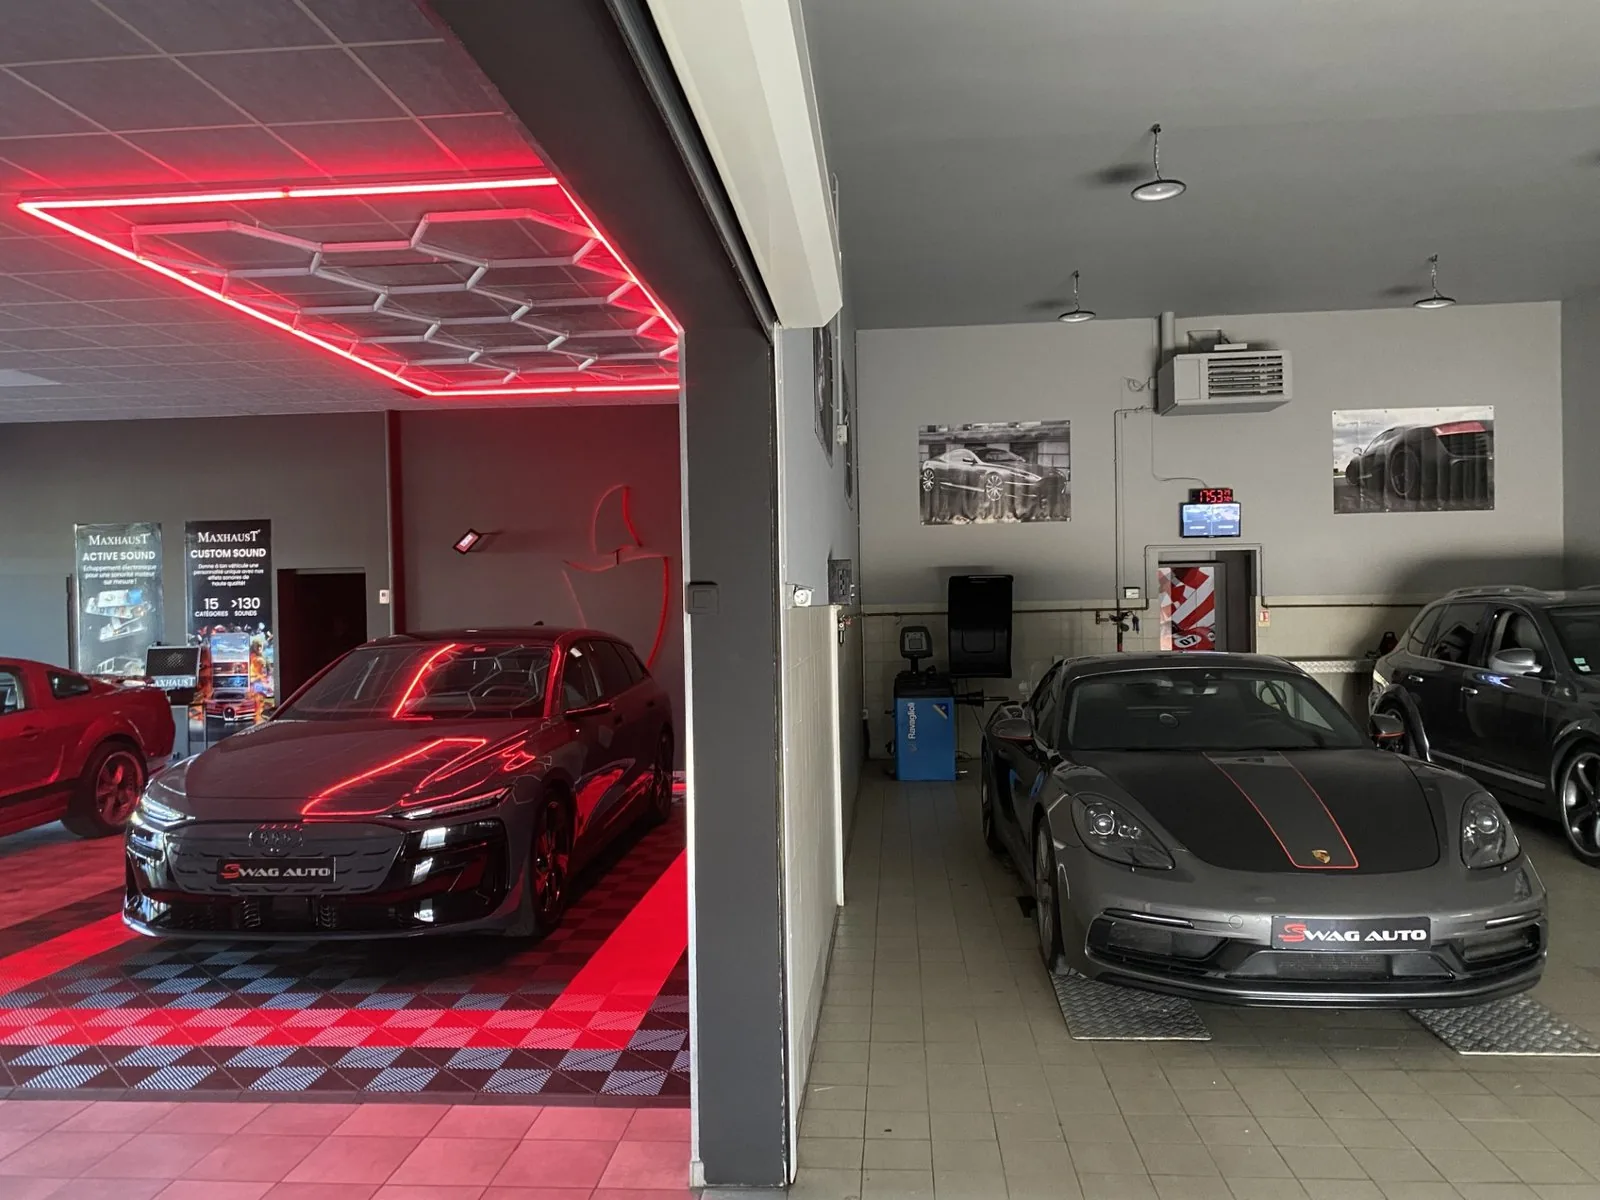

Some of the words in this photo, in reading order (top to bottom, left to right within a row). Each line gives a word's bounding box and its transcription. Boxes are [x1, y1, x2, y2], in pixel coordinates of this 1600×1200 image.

[82, 551, 118, 561] ACTIVE
[120, 550, 156, 560] SOUND
[190, 548, 231, 558] CUSTOM
[233, 548, 266, 558] SOUND
[204, 597, 219, 610] 15
[154, 676, 196, 688] AXHAUST
[221, 863, 280, 879] SWAG
[282, 867, 331, 877] AUTO
[1278, 923, 1360, 943] SWAG
[1364, 929, 1427, 942] AUTO
